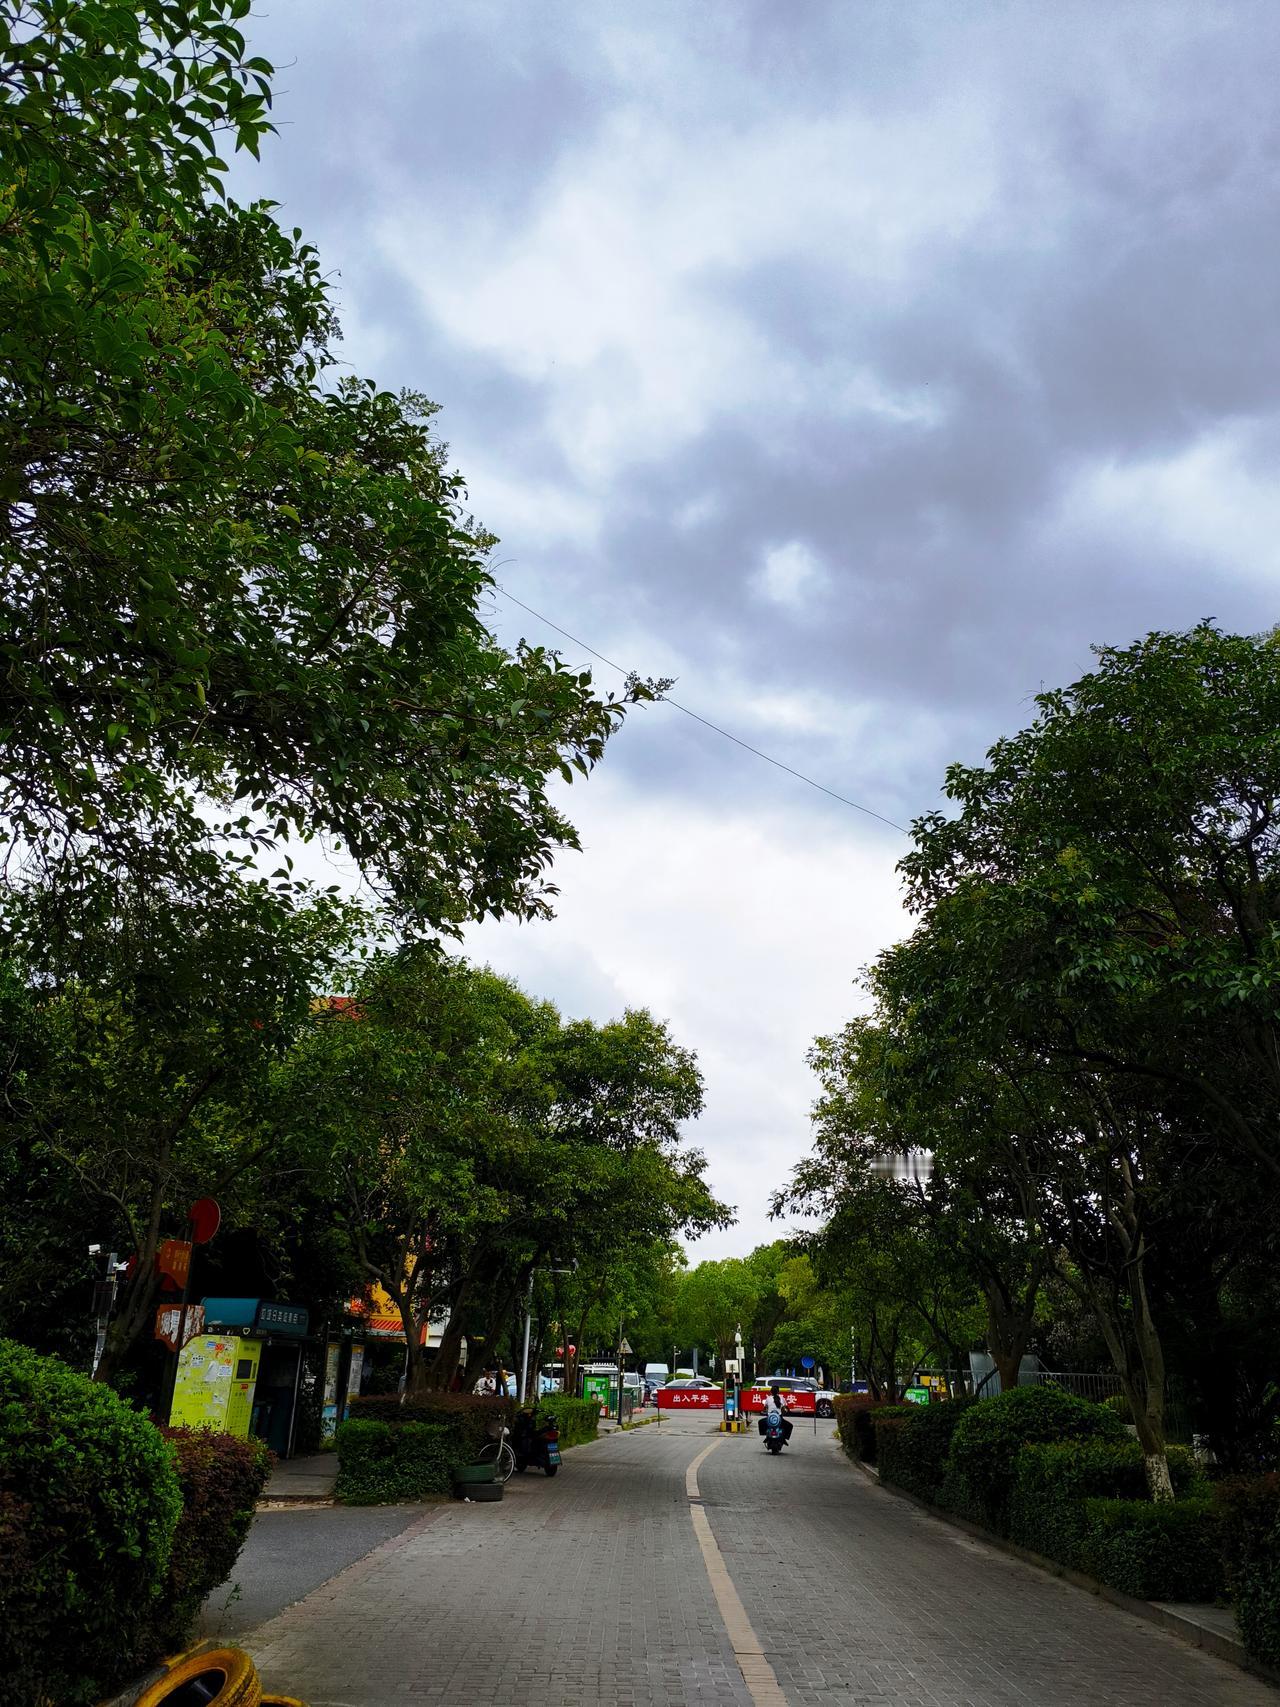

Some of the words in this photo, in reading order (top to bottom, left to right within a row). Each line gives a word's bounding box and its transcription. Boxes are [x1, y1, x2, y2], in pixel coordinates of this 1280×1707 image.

[672, 1394, 709, 1403] 出入平安
[752, 1393, 797, 1404] 出安
